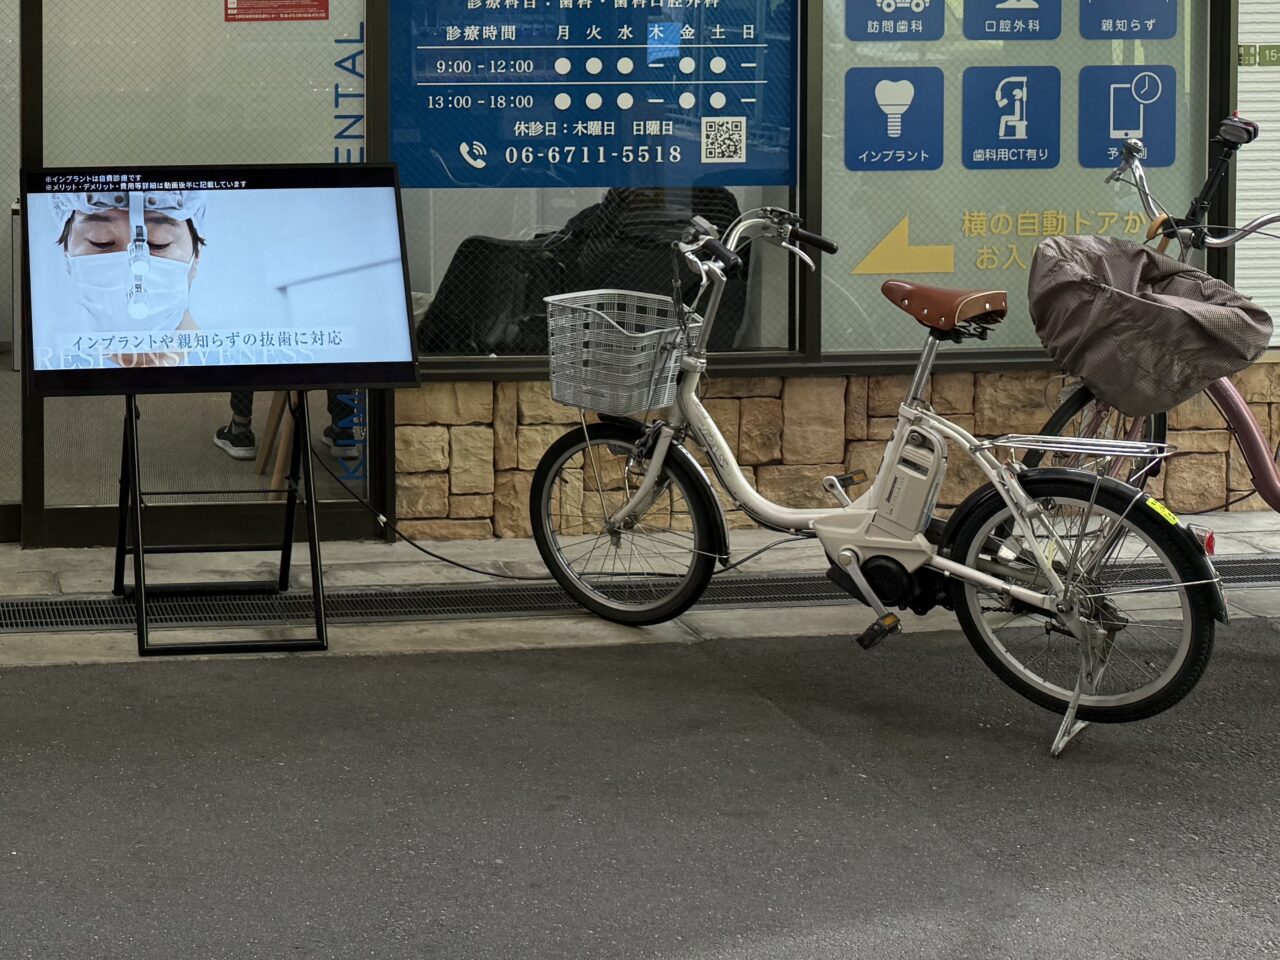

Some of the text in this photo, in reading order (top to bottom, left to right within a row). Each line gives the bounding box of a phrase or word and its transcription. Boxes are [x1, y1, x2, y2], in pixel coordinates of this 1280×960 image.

[446, 25, 754, 41] 診療時間 月 火 水 木 金 土 日
[867, 20, 924, 33] 訪問歯科
[985, 20, 1041, 33] 口腔外科
[1101, 18, 1157, 32] 親知らず
[334, 21, 365, 164] ENTAL
[505, 146, 681, 164] 06-6711-5518
[858, 149, 930, 163] インプラント
[972, 148, 1049, 162] 歯科用CT有り
[961, 210, 1146, 237] 横の自動ドアか
[976, 244, 1035, 270] お入
[73, 330, 343, 350] インプラントや親知らずの抜歯に対応
